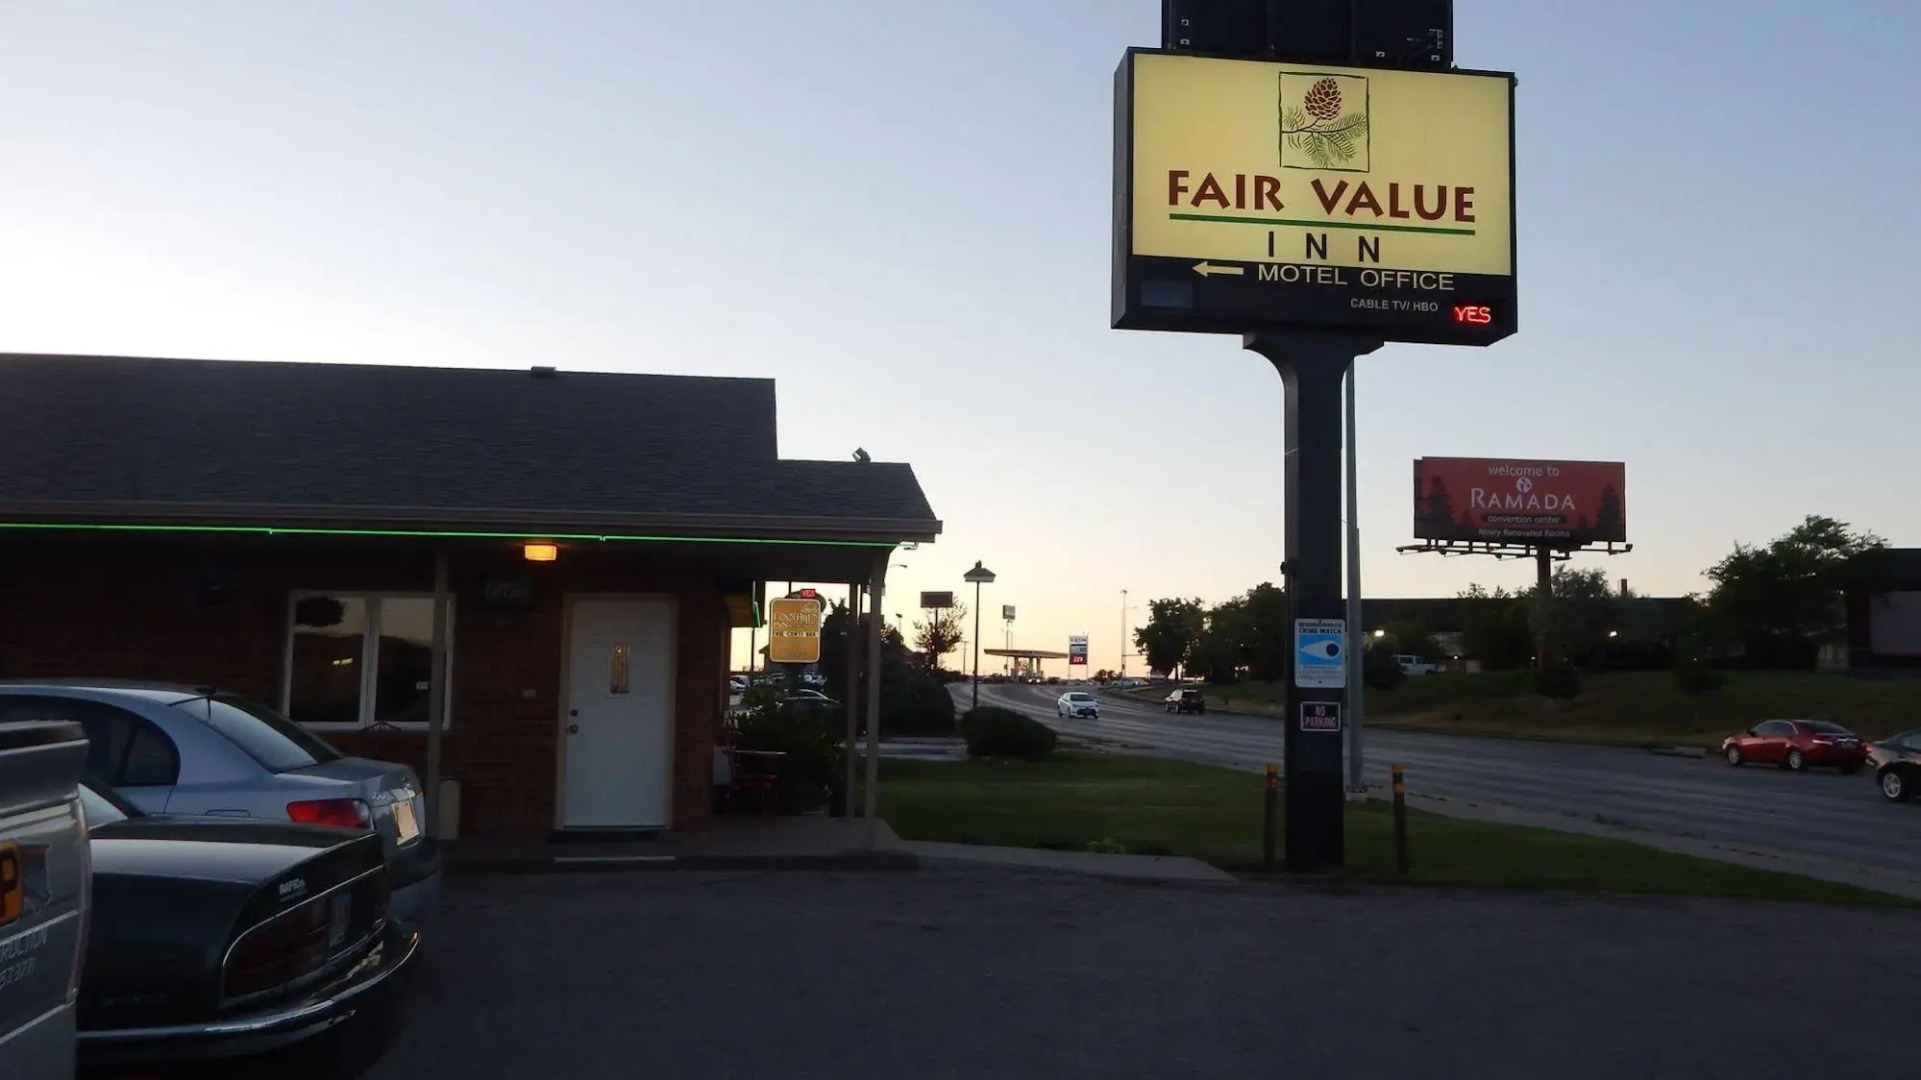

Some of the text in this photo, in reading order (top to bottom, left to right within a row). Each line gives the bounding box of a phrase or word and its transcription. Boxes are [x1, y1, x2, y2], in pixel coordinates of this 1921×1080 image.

[1168, 170, 1475, 223] FAIR VALUE
[1268, 231, 1380, 263] INN
[1258, 264, 1455, 291] MOTEL OFFICE
[1350, 298, 1390, 311] CABLE
[1413, 302, 1439, 313] HBO
[1454, 306, 1492, 324] YES
[1488, 465, 1560, 477] welcome to
[1471, 488, 1576, 511] RAMADA
[1488, 515, 1560, 525] convention center
[1545, 530, 1570, 538] Rooms
[1315, 705, 1326, 717] NO
[1304, 716, 1337, 729] PARKING
